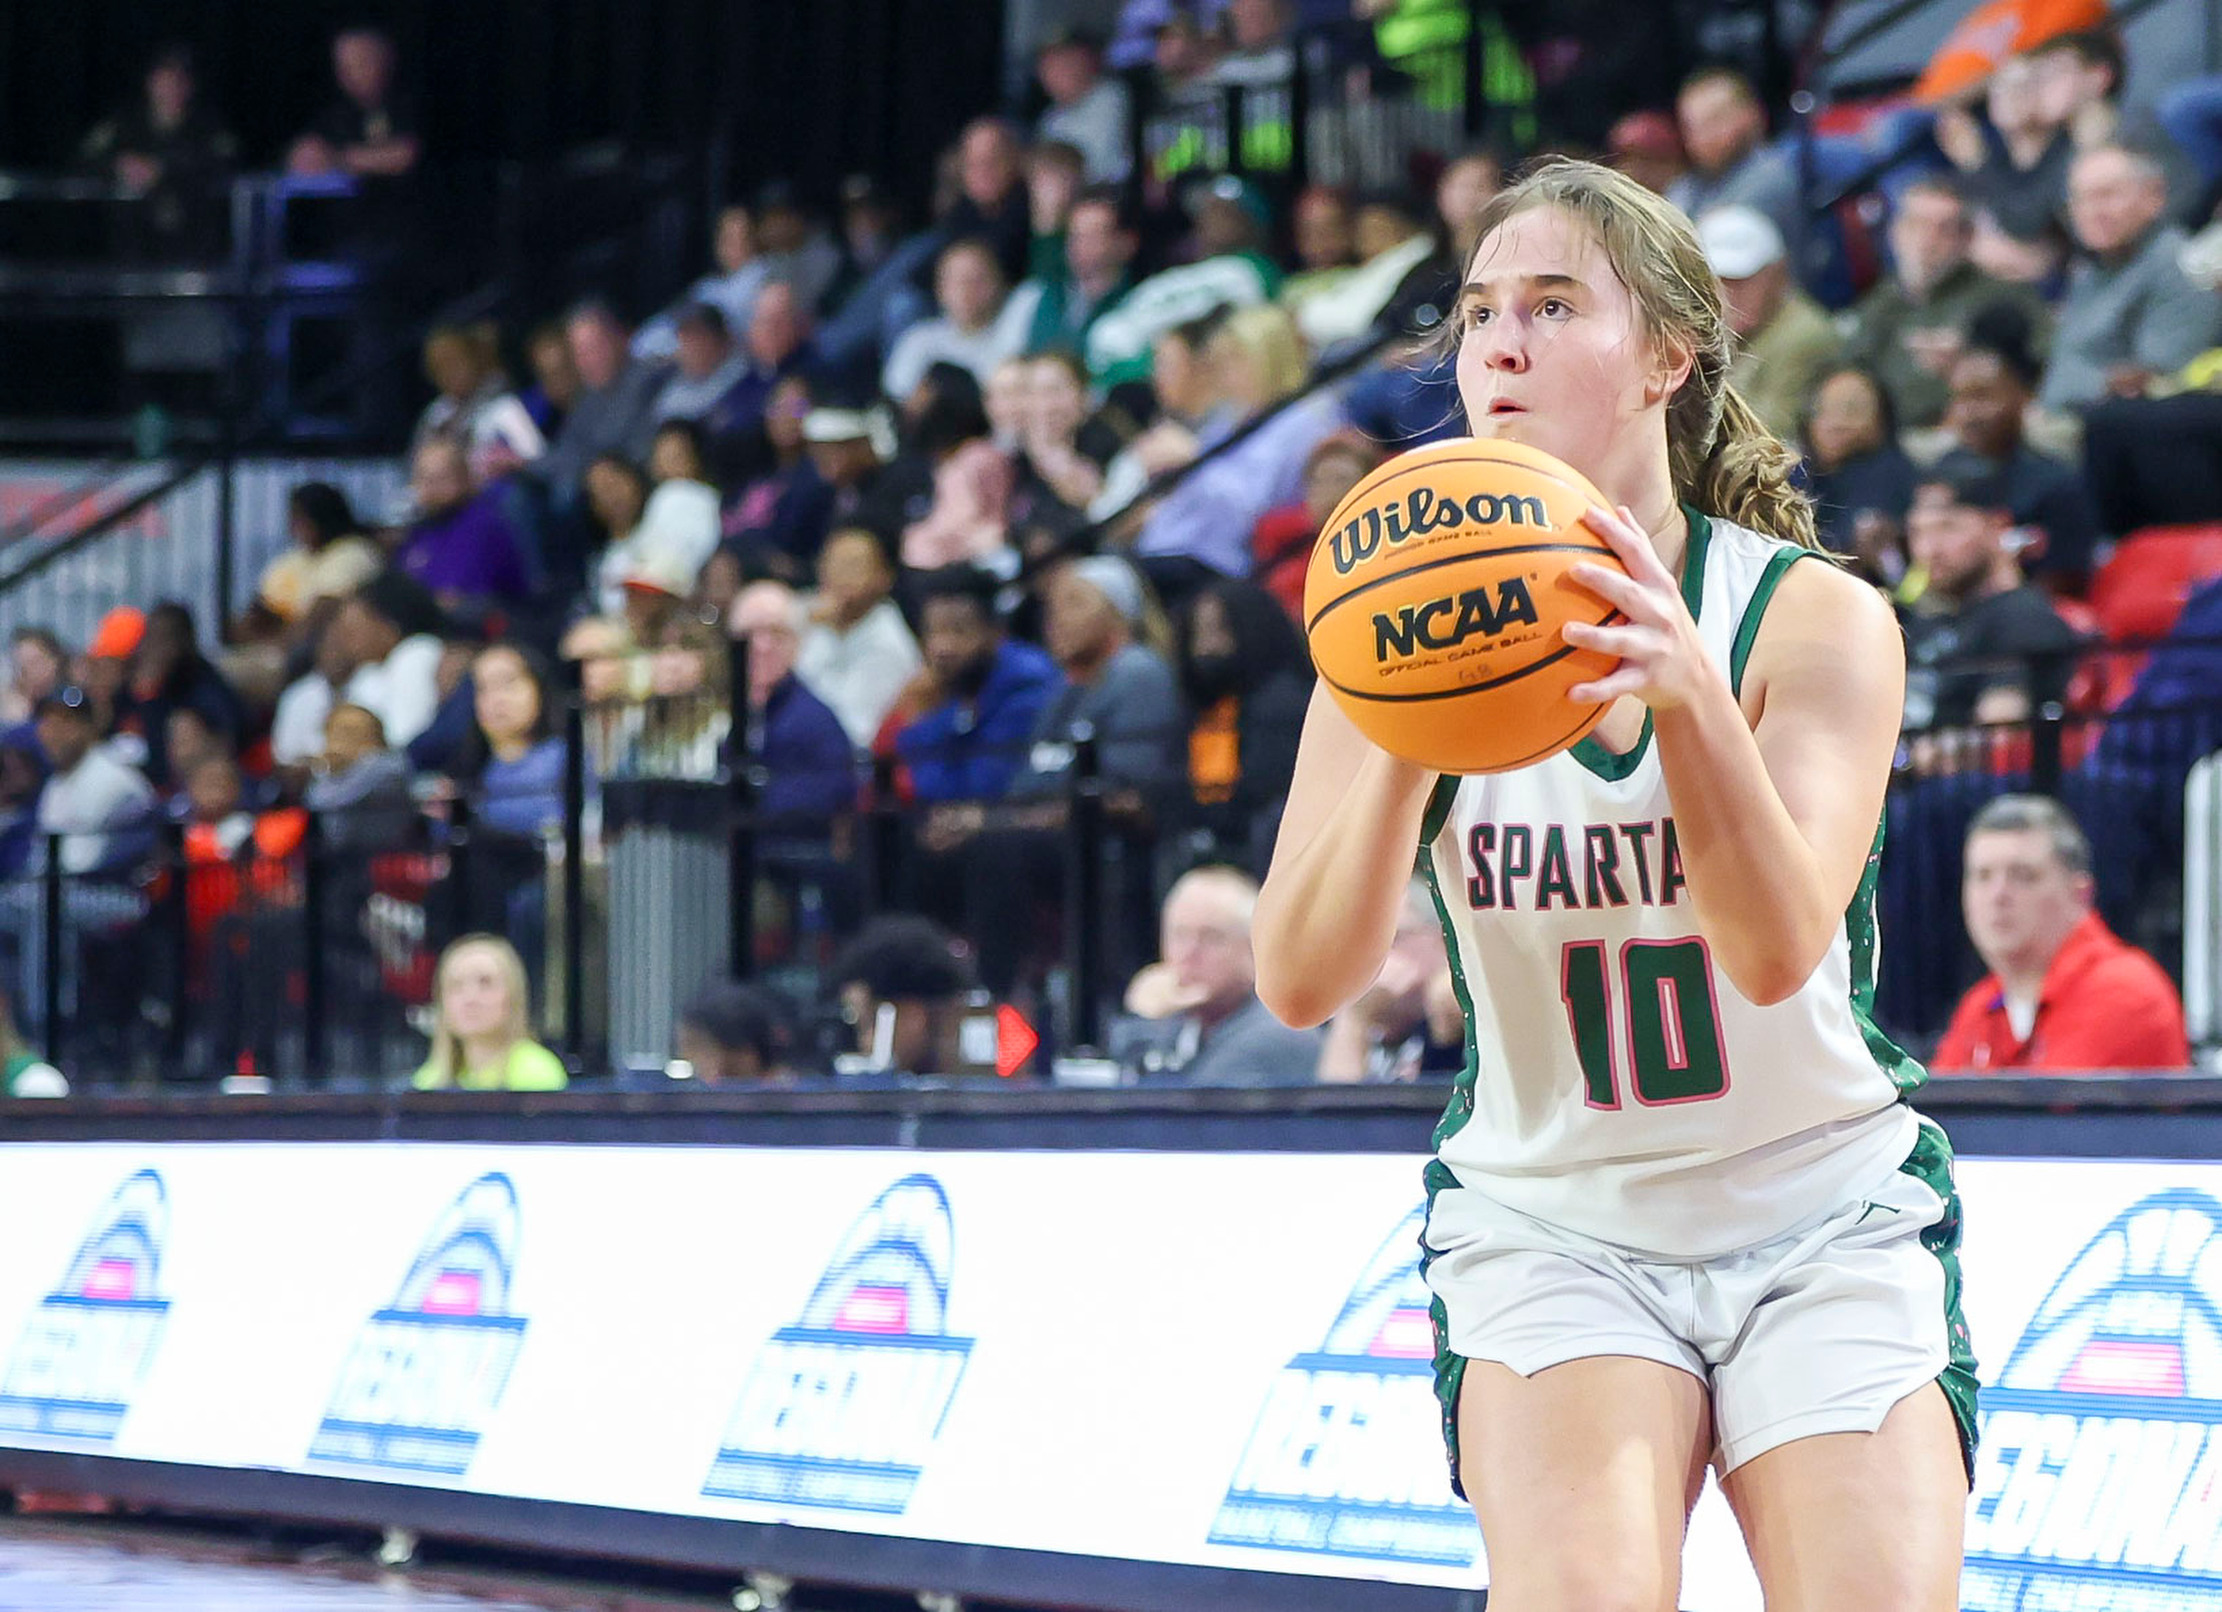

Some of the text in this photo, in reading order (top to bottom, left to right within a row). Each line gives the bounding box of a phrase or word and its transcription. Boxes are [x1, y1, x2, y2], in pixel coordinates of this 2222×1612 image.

[1329, 487, 1551, 575] Wilson
[1372, 576, 1539, 662] NCAA
[1379, 632, 1544, 677] OFFICIAL GAME BALL
[1560, 935, 1731, 1111] 10
